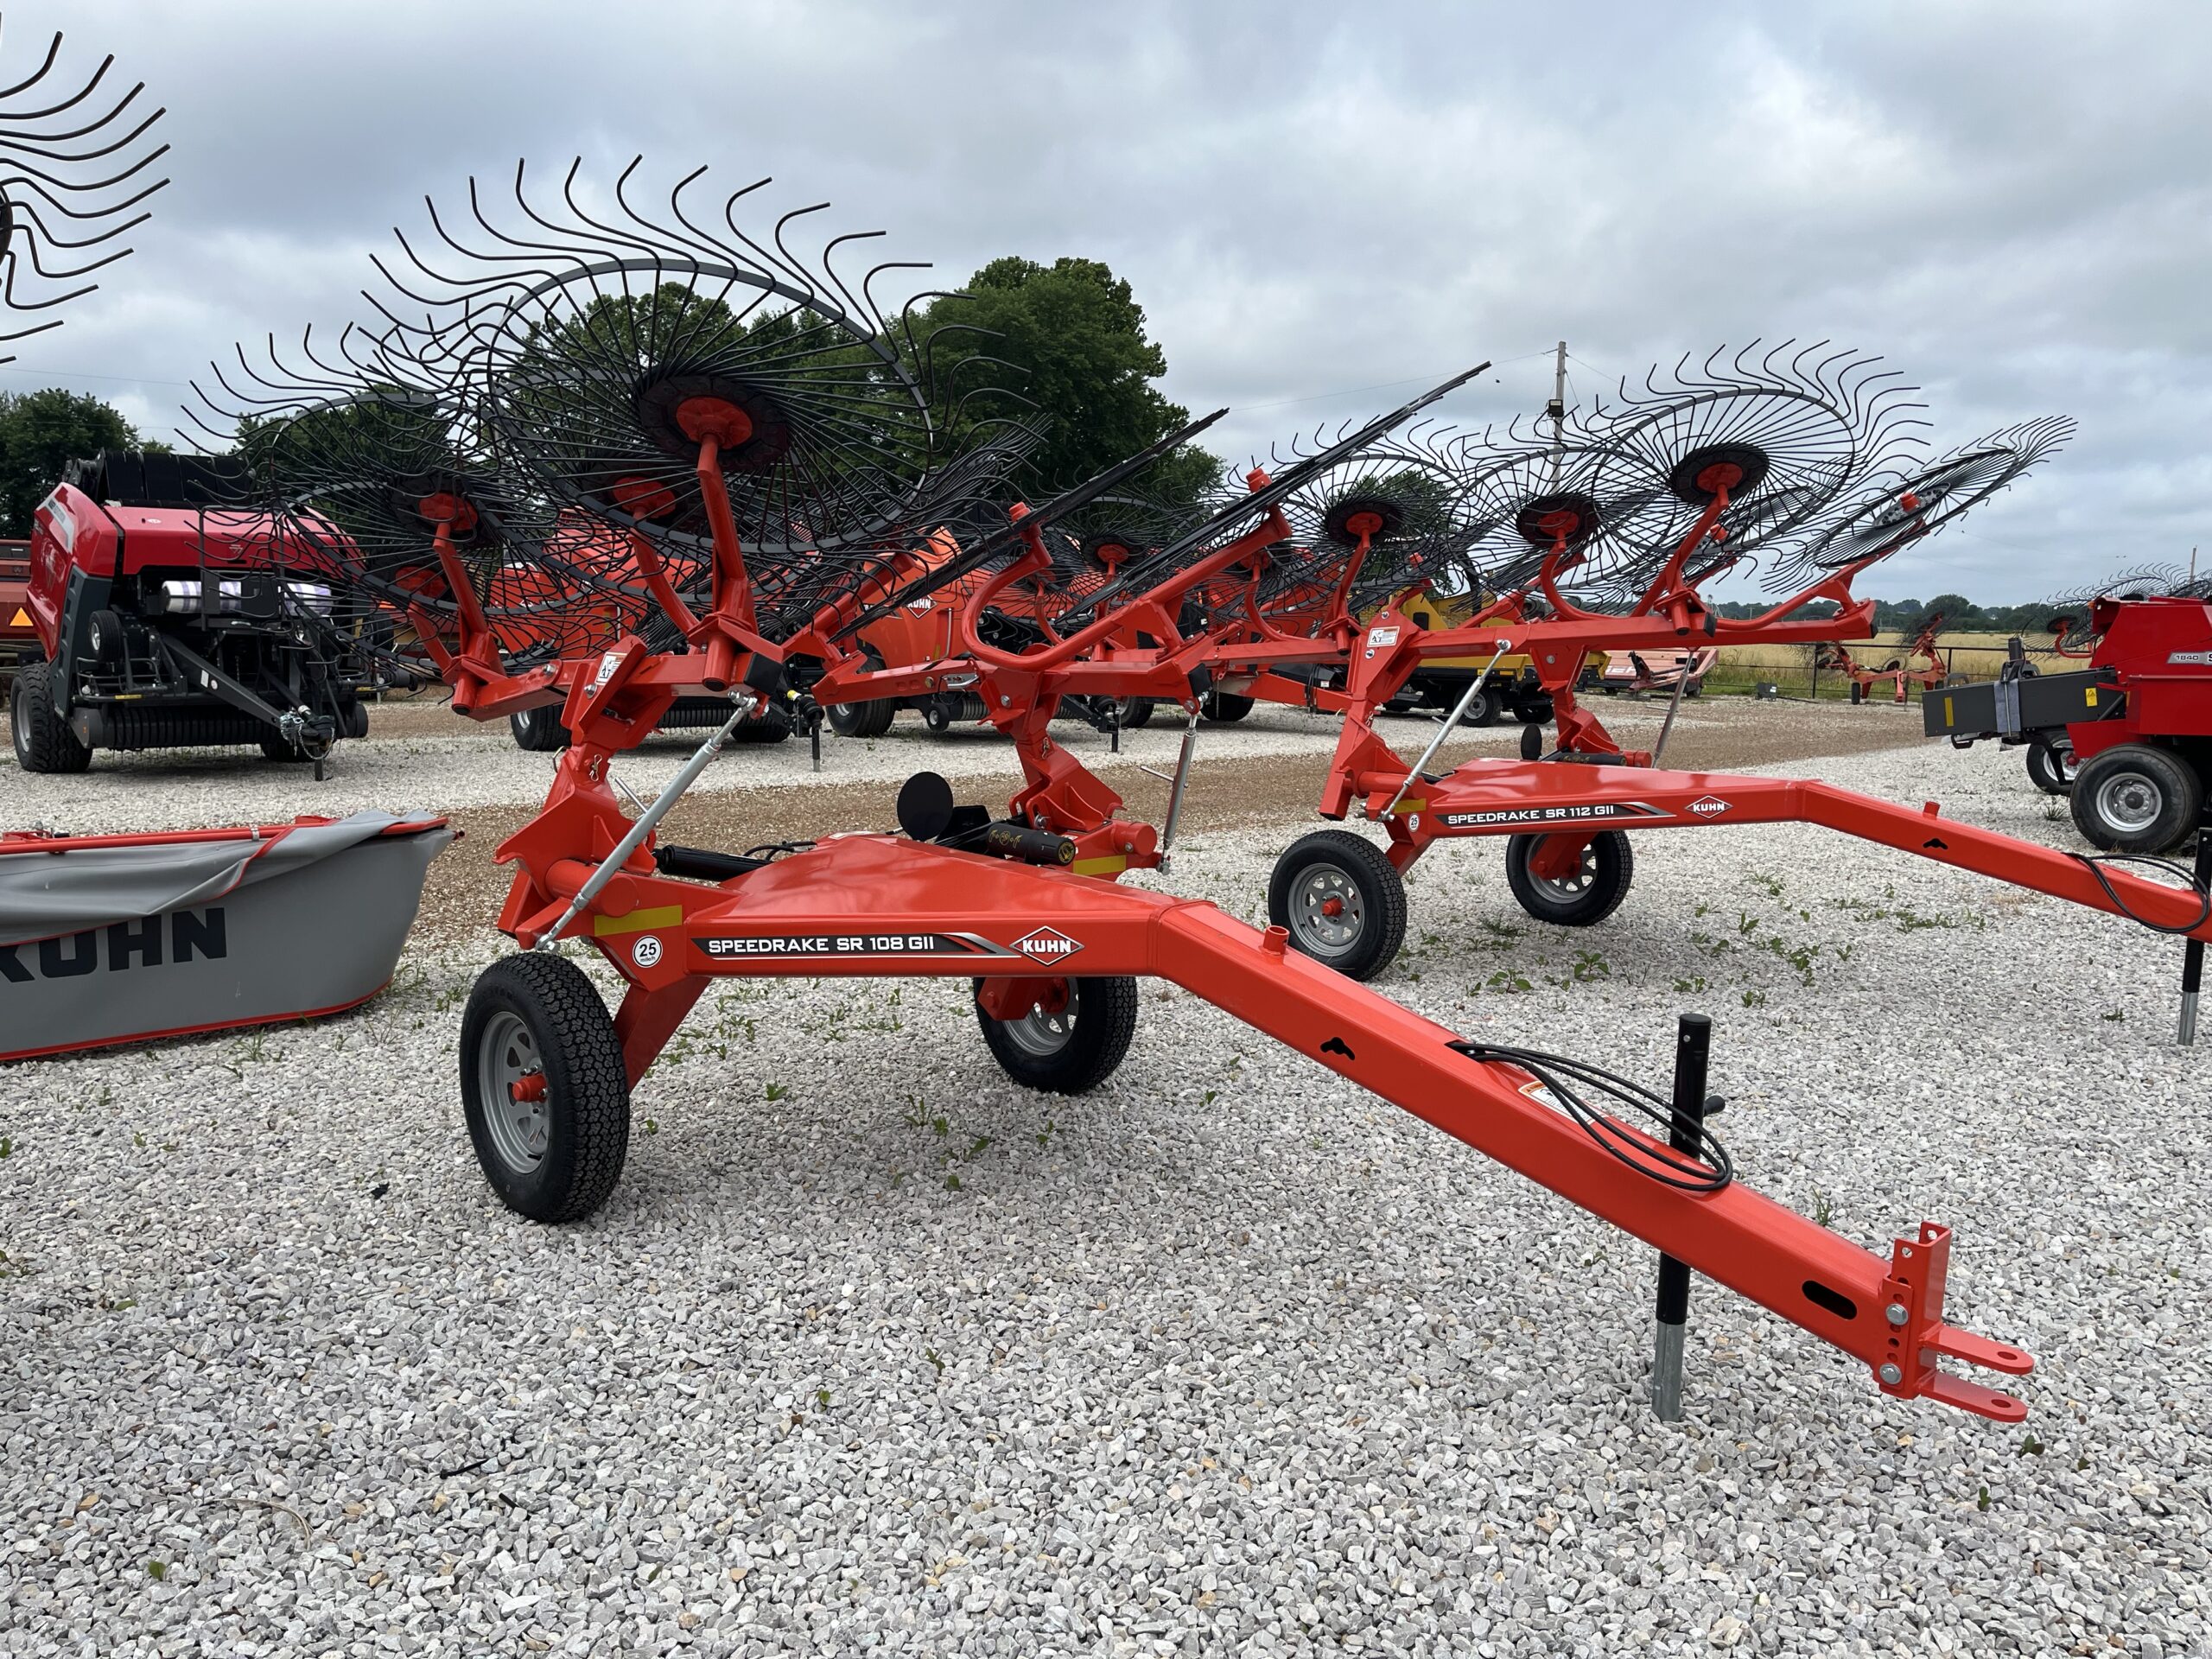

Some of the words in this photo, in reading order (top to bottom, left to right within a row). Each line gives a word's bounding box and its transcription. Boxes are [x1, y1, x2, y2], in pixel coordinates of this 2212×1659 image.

[1448, 810, 1540, 824] SPEEDRAKE
[1545, 808, 1566, 818] SR
[1570, 806, 1591, 817] 112
[1595, 805, 1614, 815] GII
[1693, 803, 1726, 812] KUHN
[639, 943, 657, 957] 25
[709, 938, 829, 953] SPEEDRAKE
[836, 938, 865, 950] SR
[869, 937, 905, 950] 108
[908, 936, 935, 950] GII
[1022, 939, 1071, 953] KUHN
